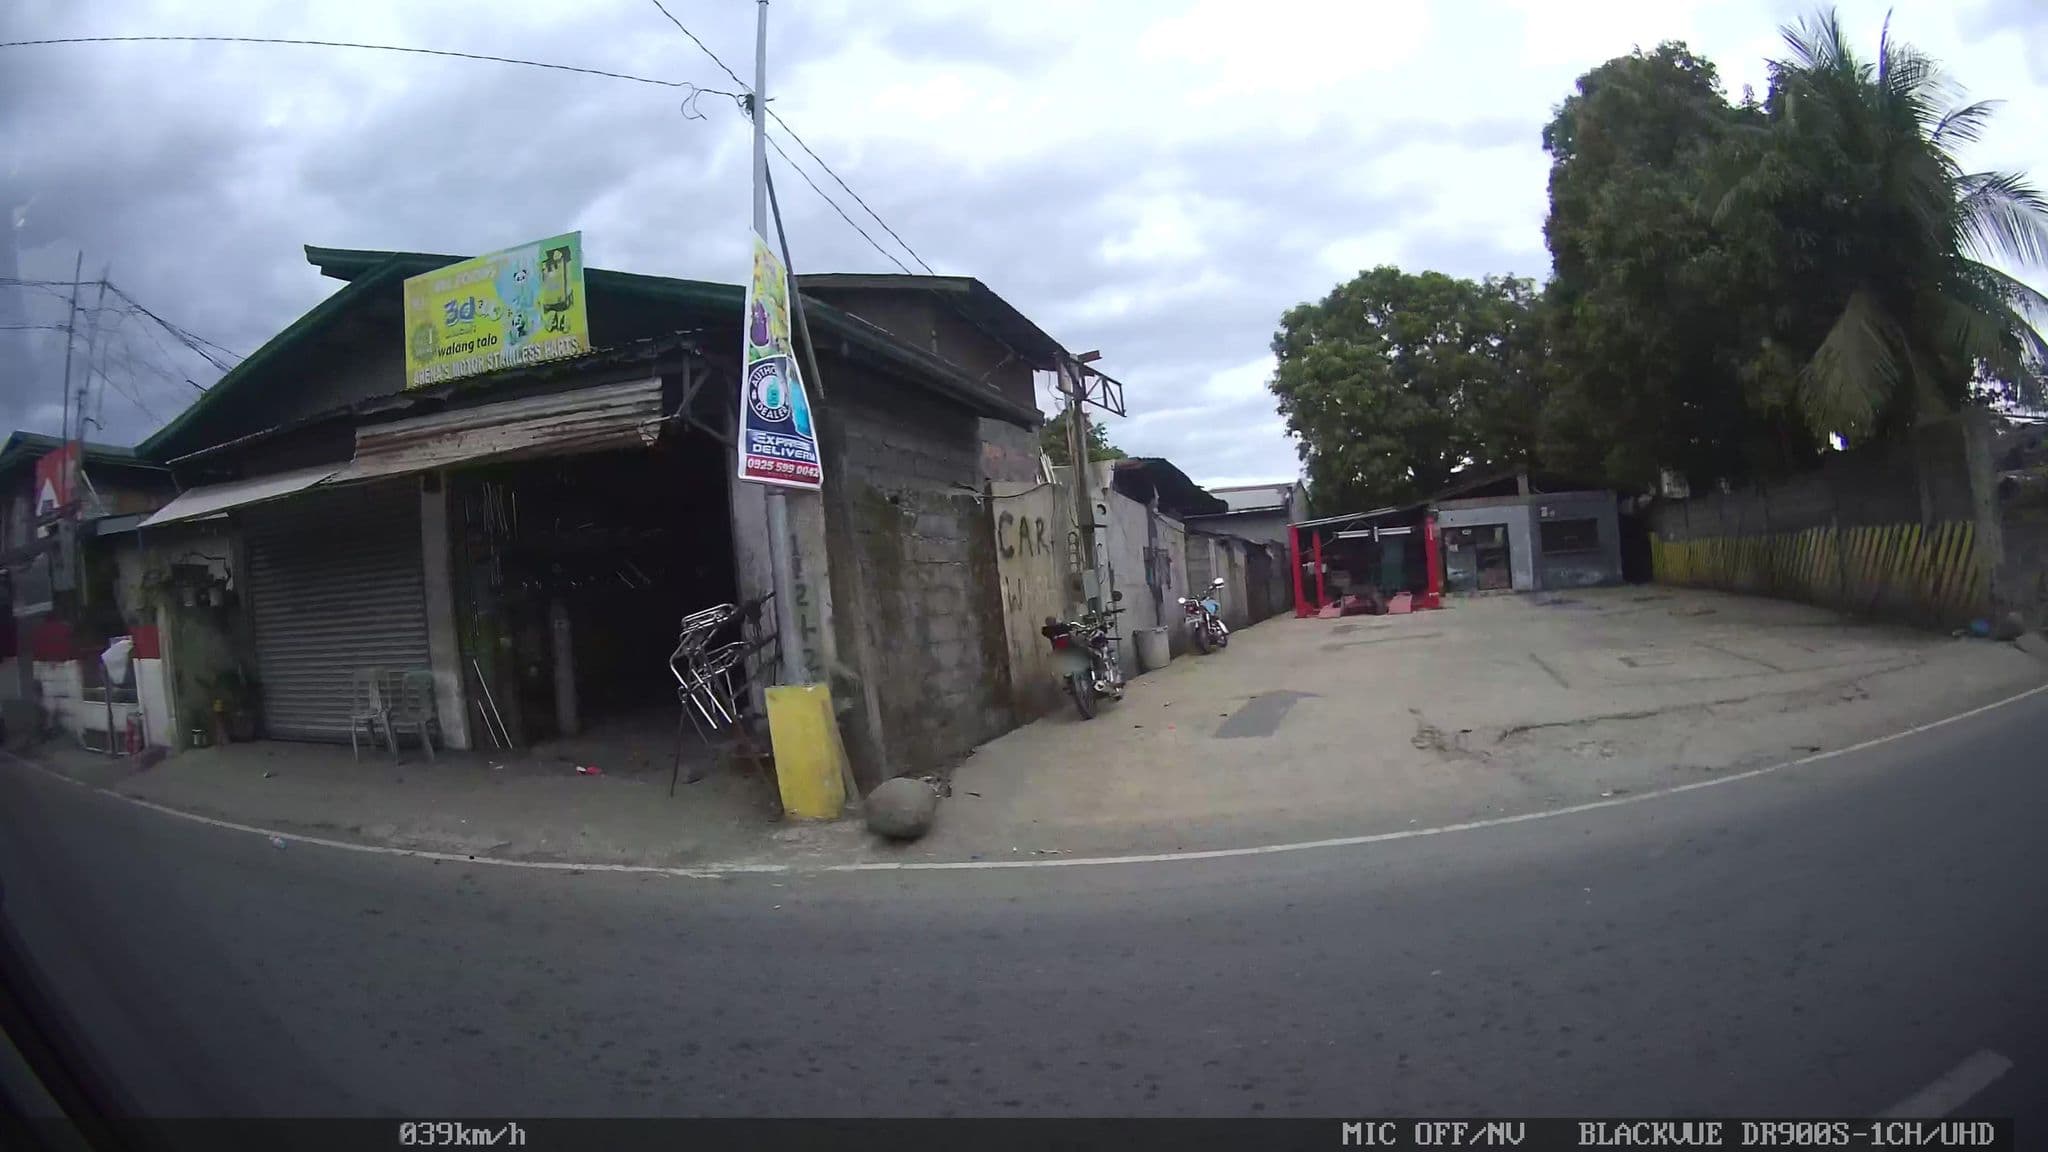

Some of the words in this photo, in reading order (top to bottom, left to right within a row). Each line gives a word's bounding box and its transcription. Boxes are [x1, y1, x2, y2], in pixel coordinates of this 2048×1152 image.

[438, 340, 475, 358] walang
[477, 333, 498, 349] talo
[451, 357, 484, 378] MOTOR
[486, 344, 541, 369] STAINLESS
[748, 458, 774, 471] 0925
[775, 461, 795, 473] 599
[998, 510, 1051, 560] CAR
